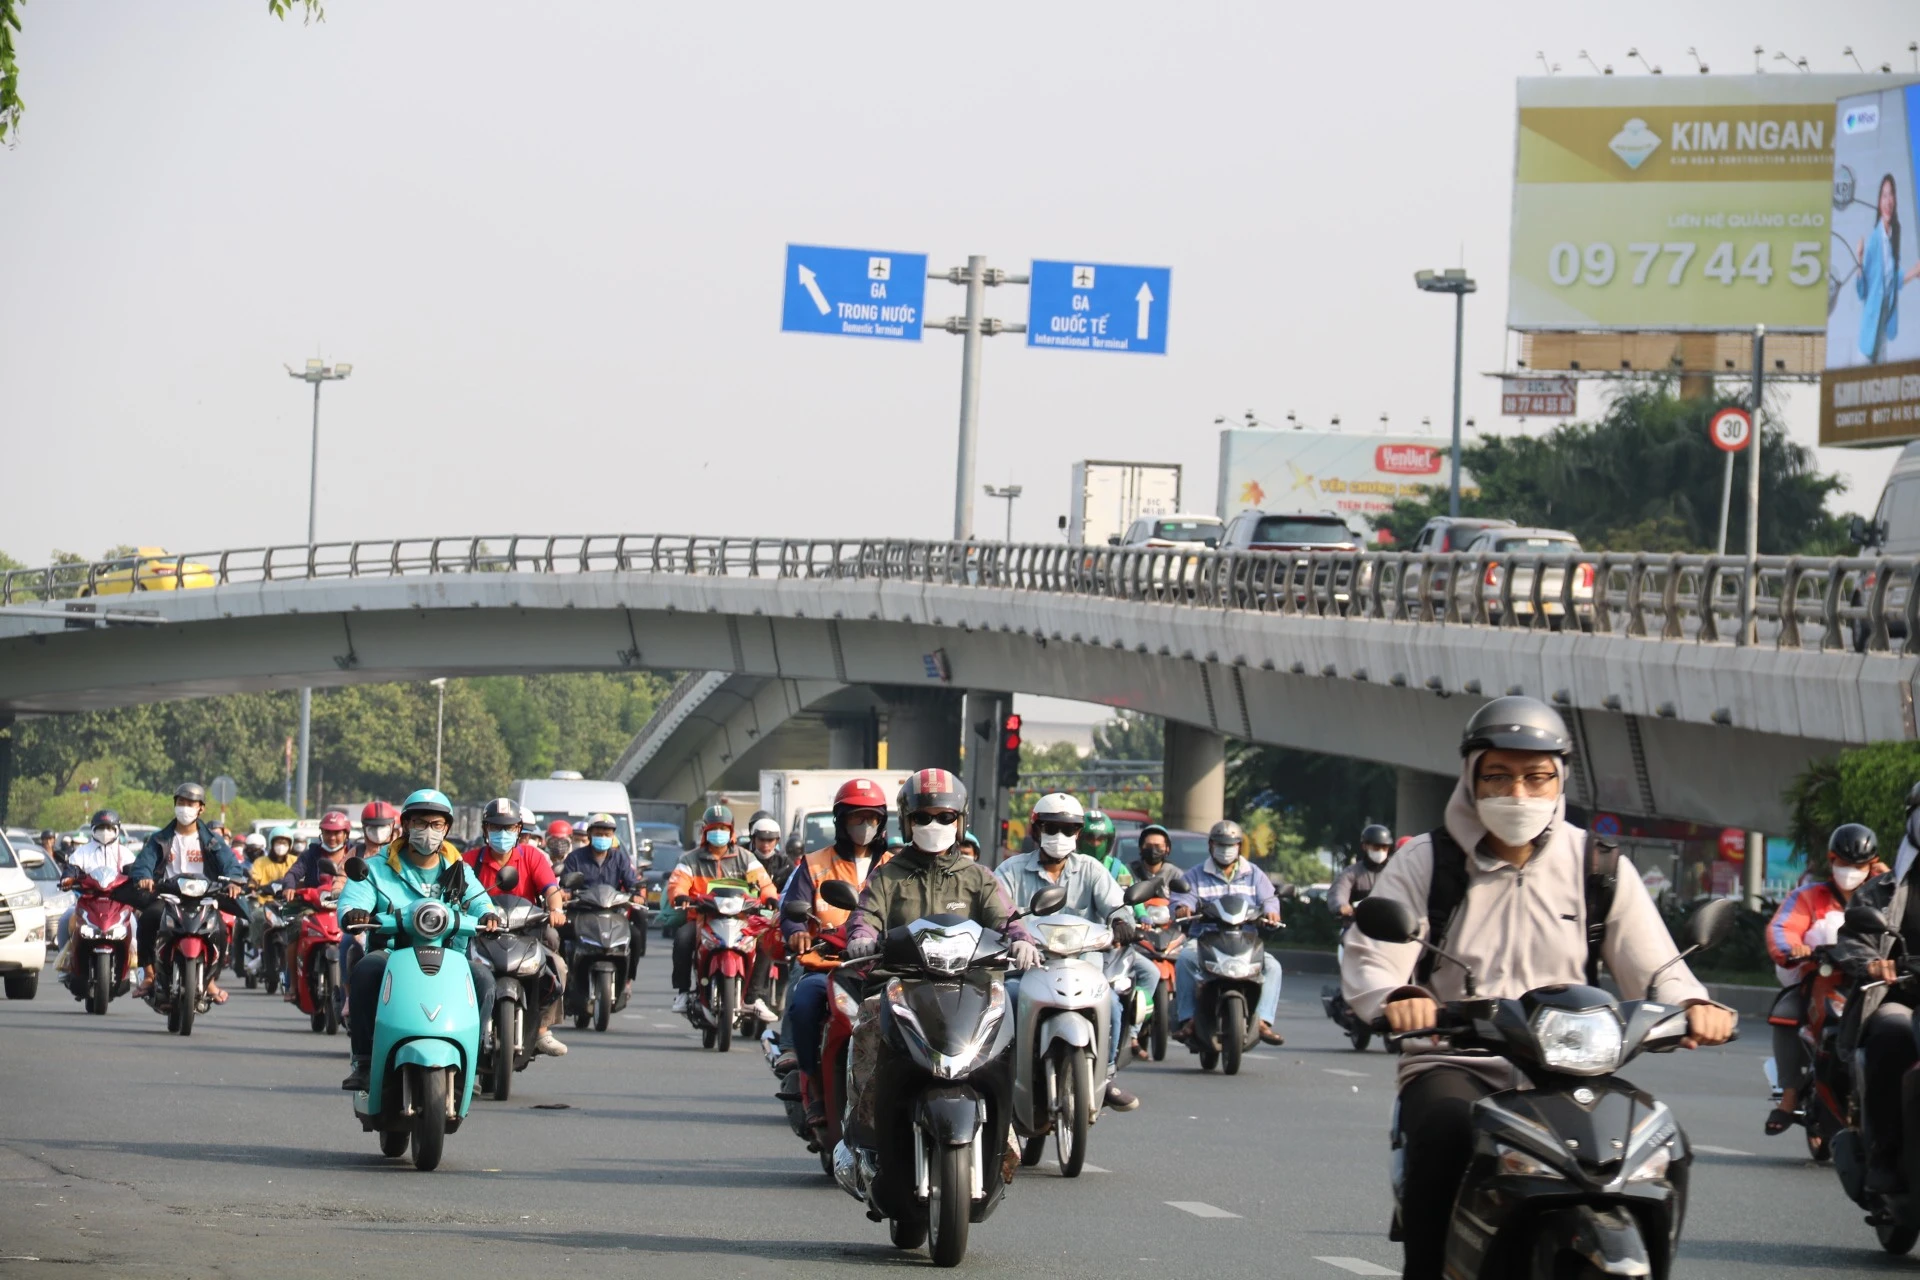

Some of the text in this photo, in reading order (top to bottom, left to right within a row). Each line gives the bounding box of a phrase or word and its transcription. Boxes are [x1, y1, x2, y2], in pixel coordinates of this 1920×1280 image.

[1671, 121, 1729, 150] KIM
[1736, 120, 1824, 150] NGAN
[1667, 209, 1825, 230] LIÊN HỆ QUẢNG CÁO
[1548, 241, 1829, 287] 09 77 44 5
[870, 282, 887, 299] GA
[1072, 294, 1090, 311] GA
[837, 302, 916, 324] TRONG NƯỚC
[842, 321, 904, 336] Domestic Terminal
[1051, 313, 1110, 335] QUỐC TẾ
[1034, 333, 1128, 349] International Terminal
[1723, 420, 1742, 438] 30
